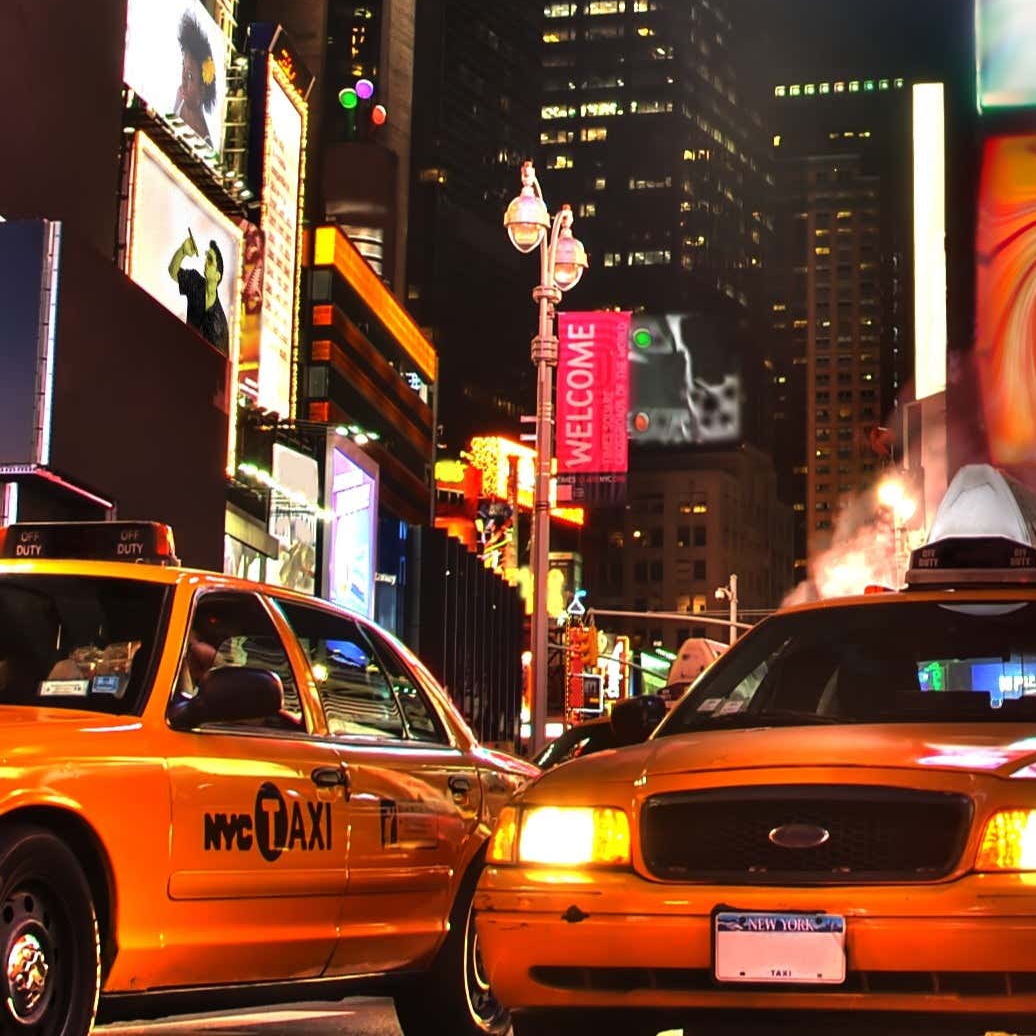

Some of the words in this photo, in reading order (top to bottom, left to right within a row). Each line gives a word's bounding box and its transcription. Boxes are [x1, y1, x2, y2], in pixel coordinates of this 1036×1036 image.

[565, 323, 596, 468] WELCOME
[21, 531, 39, 542] OFF
[121, 530, 139, 540] OFF
[16, 544, 42, 556] DUTY
[117, 543, 143, 555] DUTY
[203, 812, 252, 851] NYC
[256, 790, 332, 856] TAXI
[747, 917, 776, 931] NEW
[779, 917, 815, 931] YORK
[770, 969, 792, 977] TAXI
